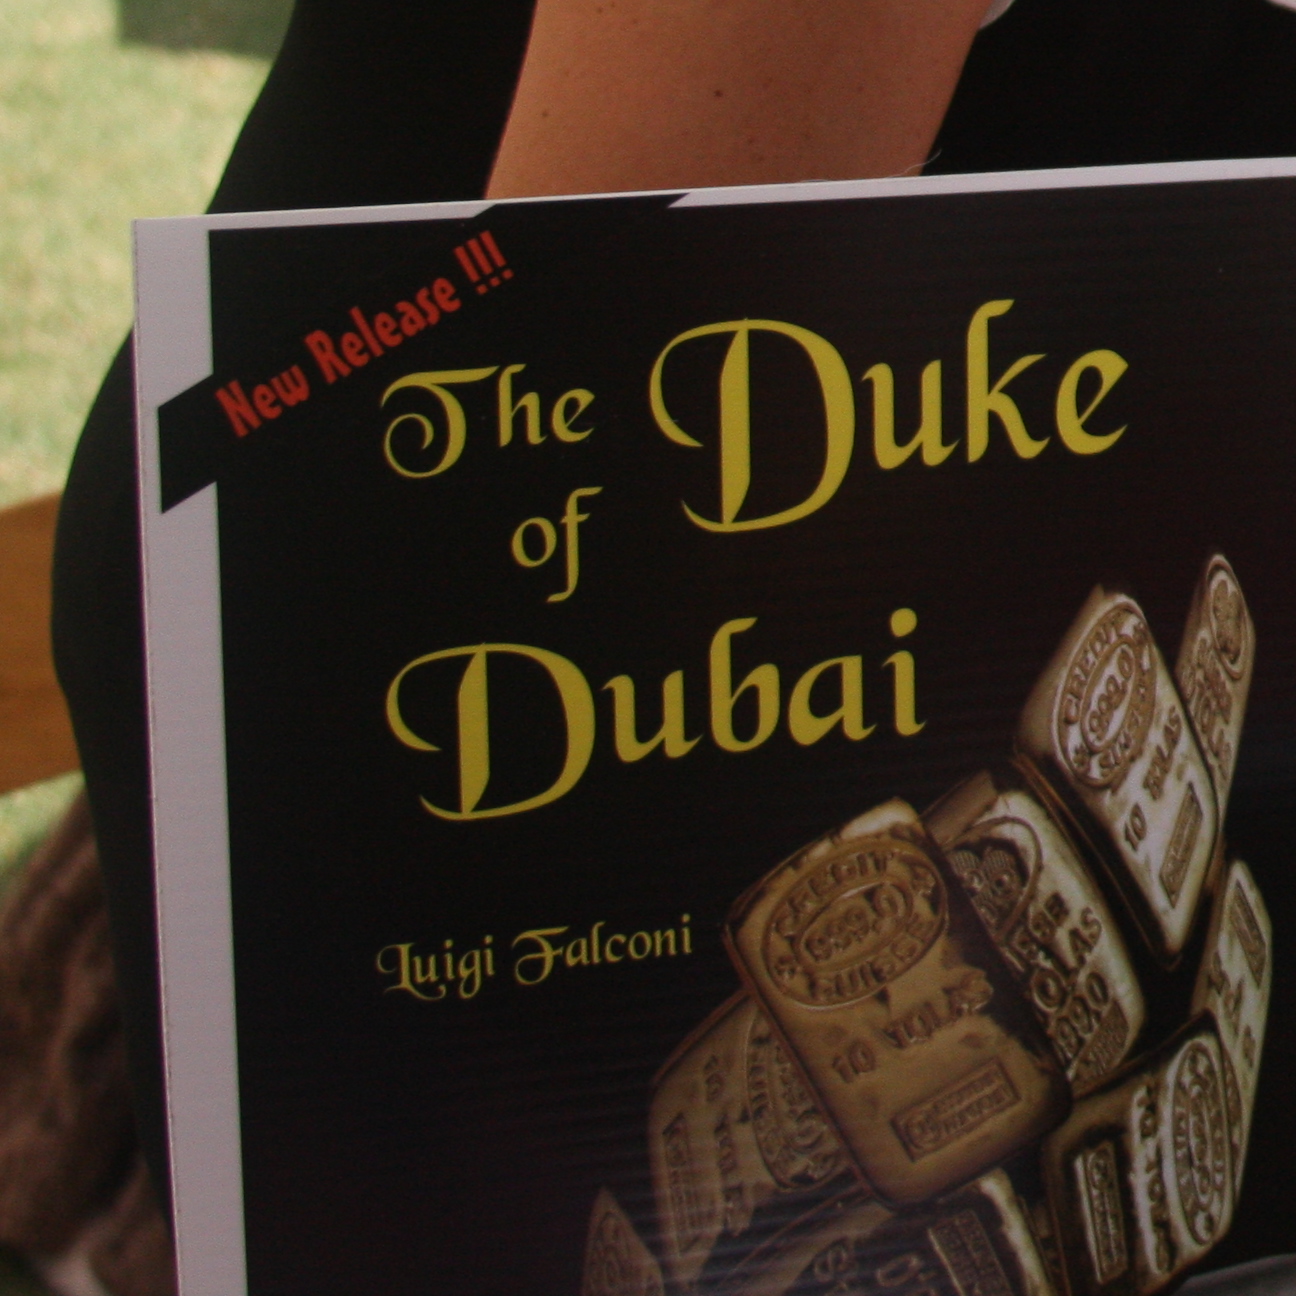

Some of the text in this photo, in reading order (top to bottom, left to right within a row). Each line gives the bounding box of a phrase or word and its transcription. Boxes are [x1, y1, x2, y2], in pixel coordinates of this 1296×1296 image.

[215, 230, 515, 438] New Release !!!
[381, 298, 1129, 533] The Duke
[511, 486, 603, 603] of
[386, 607, 926, 821] Dubai
[376, 912, 693, 1000] Luigi Falconi
[832, 1039, 877, 1084] 10
